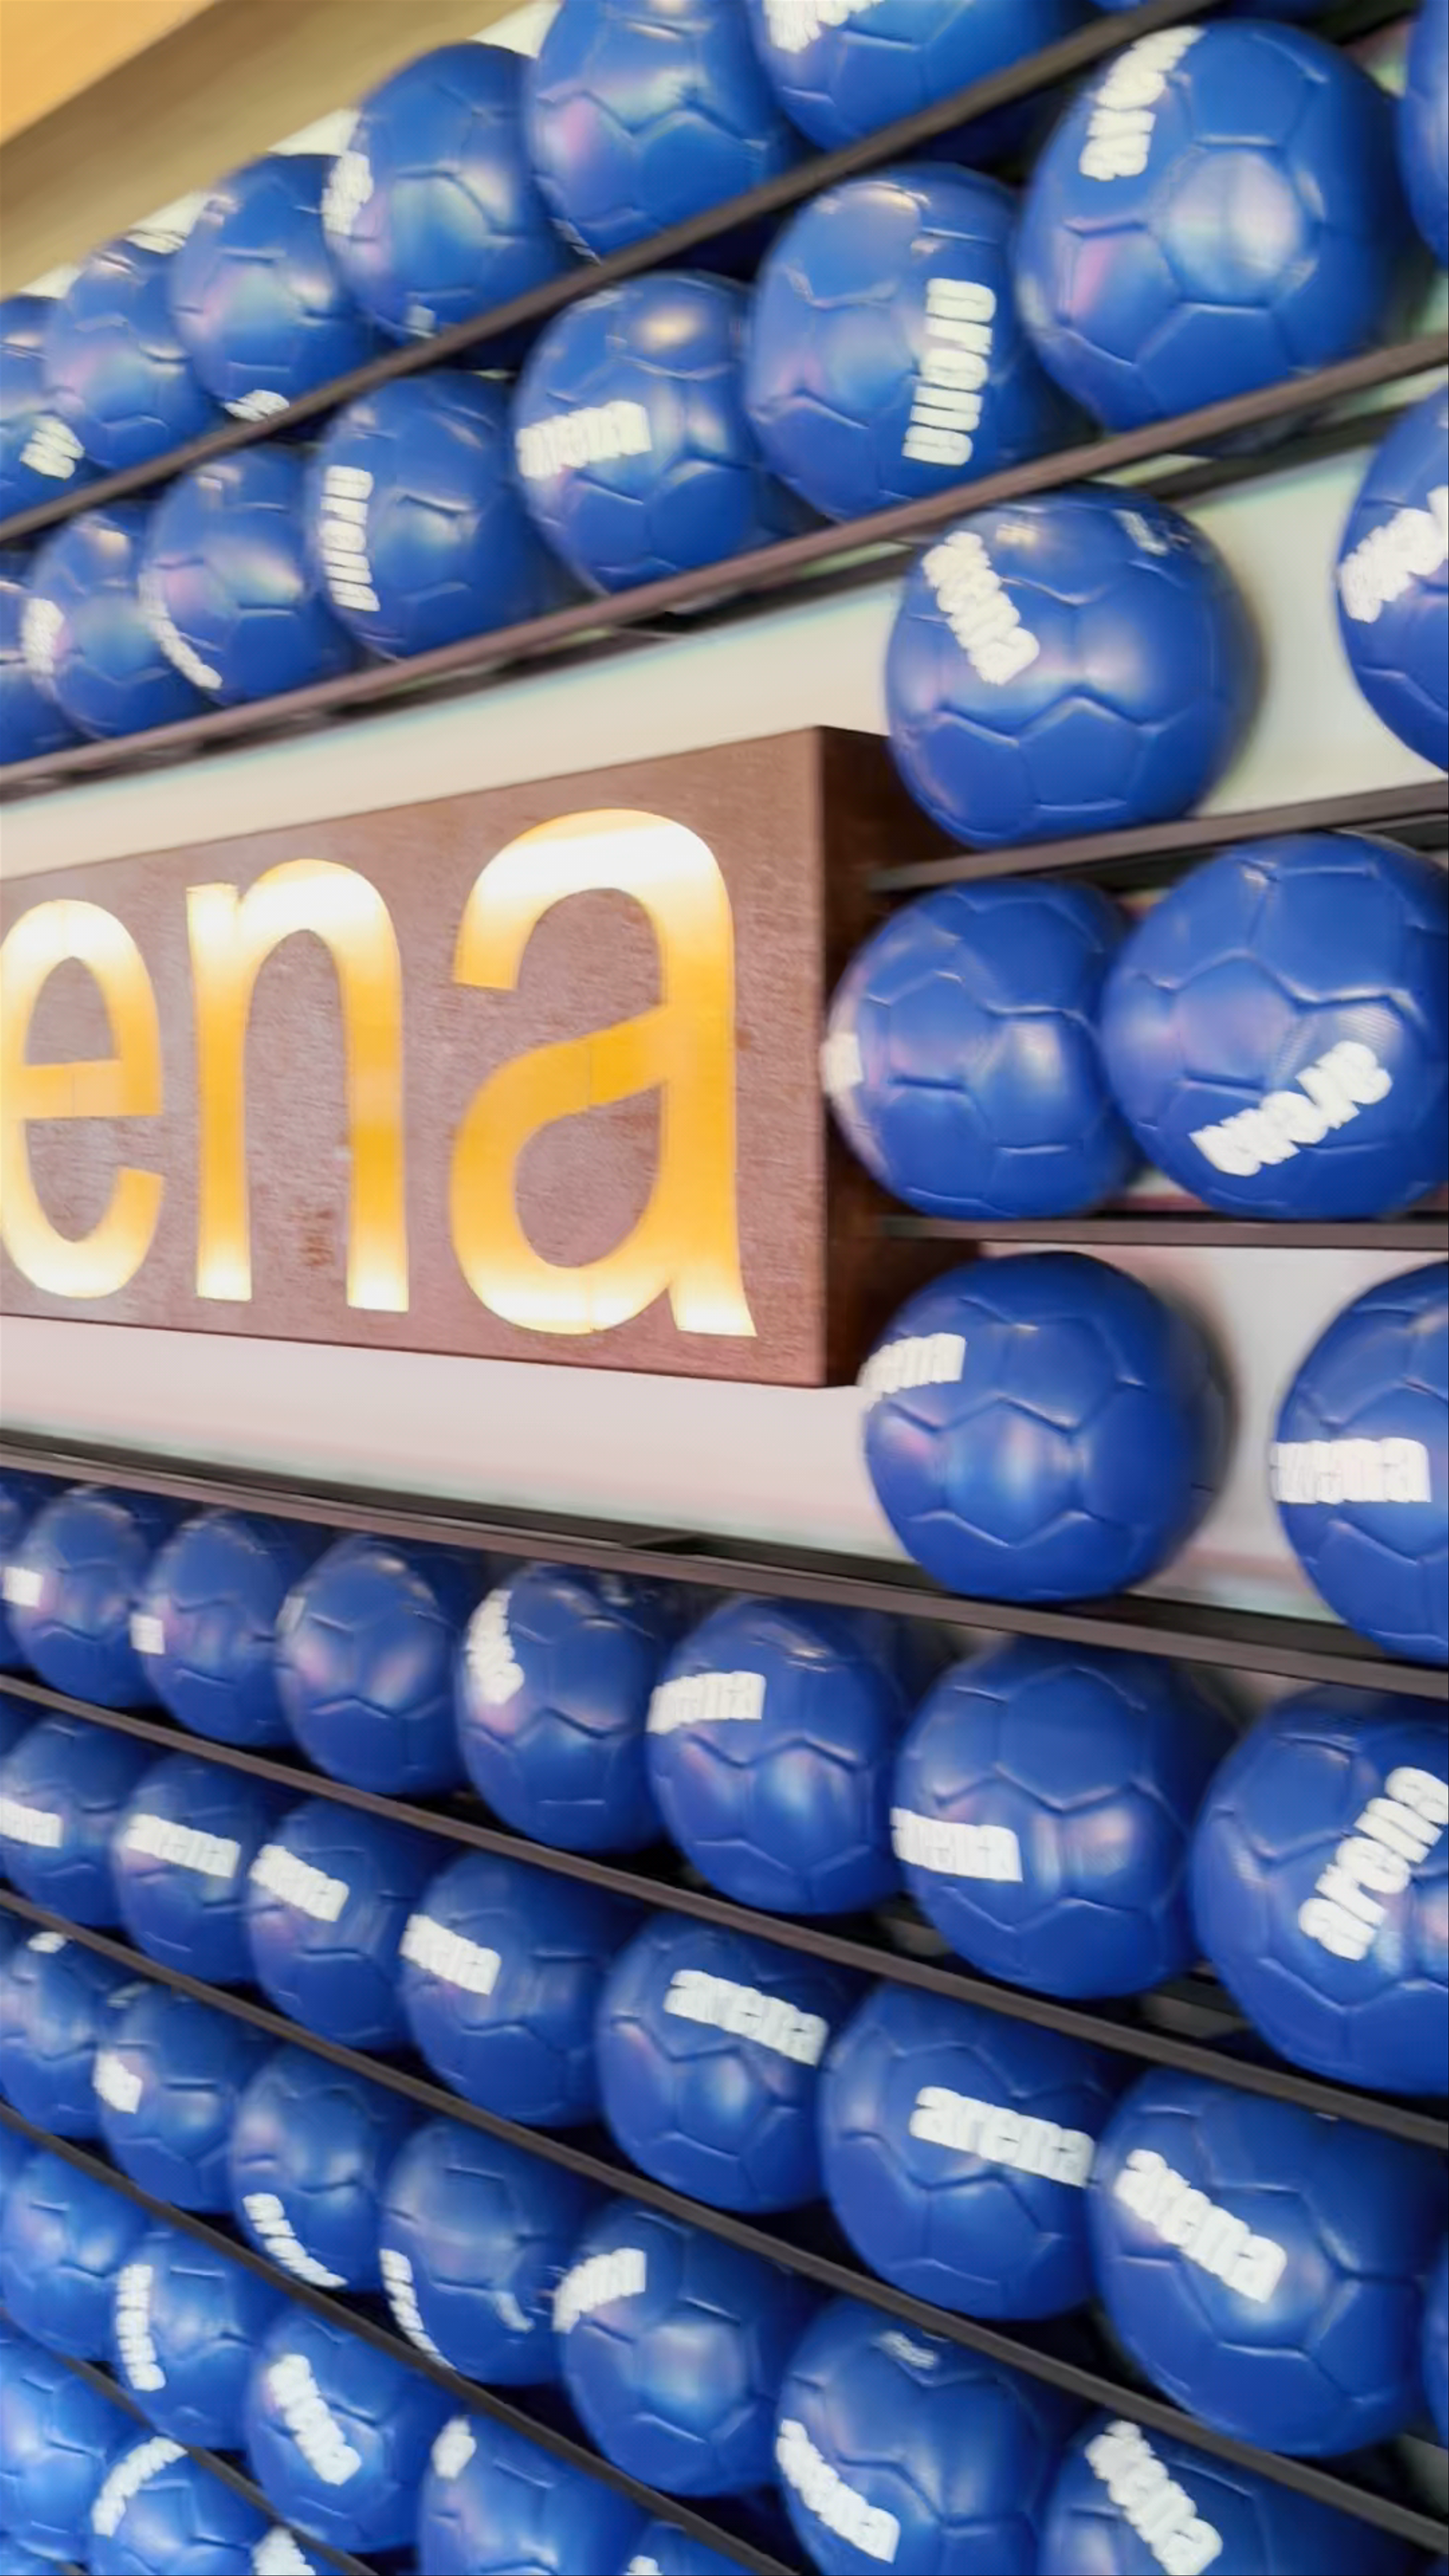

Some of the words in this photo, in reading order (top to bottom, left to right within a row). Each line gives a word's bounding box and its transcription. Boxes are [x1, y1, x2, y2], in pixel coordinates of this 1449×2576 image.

[1298, 1766, 1449, 1960] arena
[664, 1969, 827, 2064] arena
[909, 2086, 1095, 2187] arena
[1113, 2148, 1287, 2304] arena
